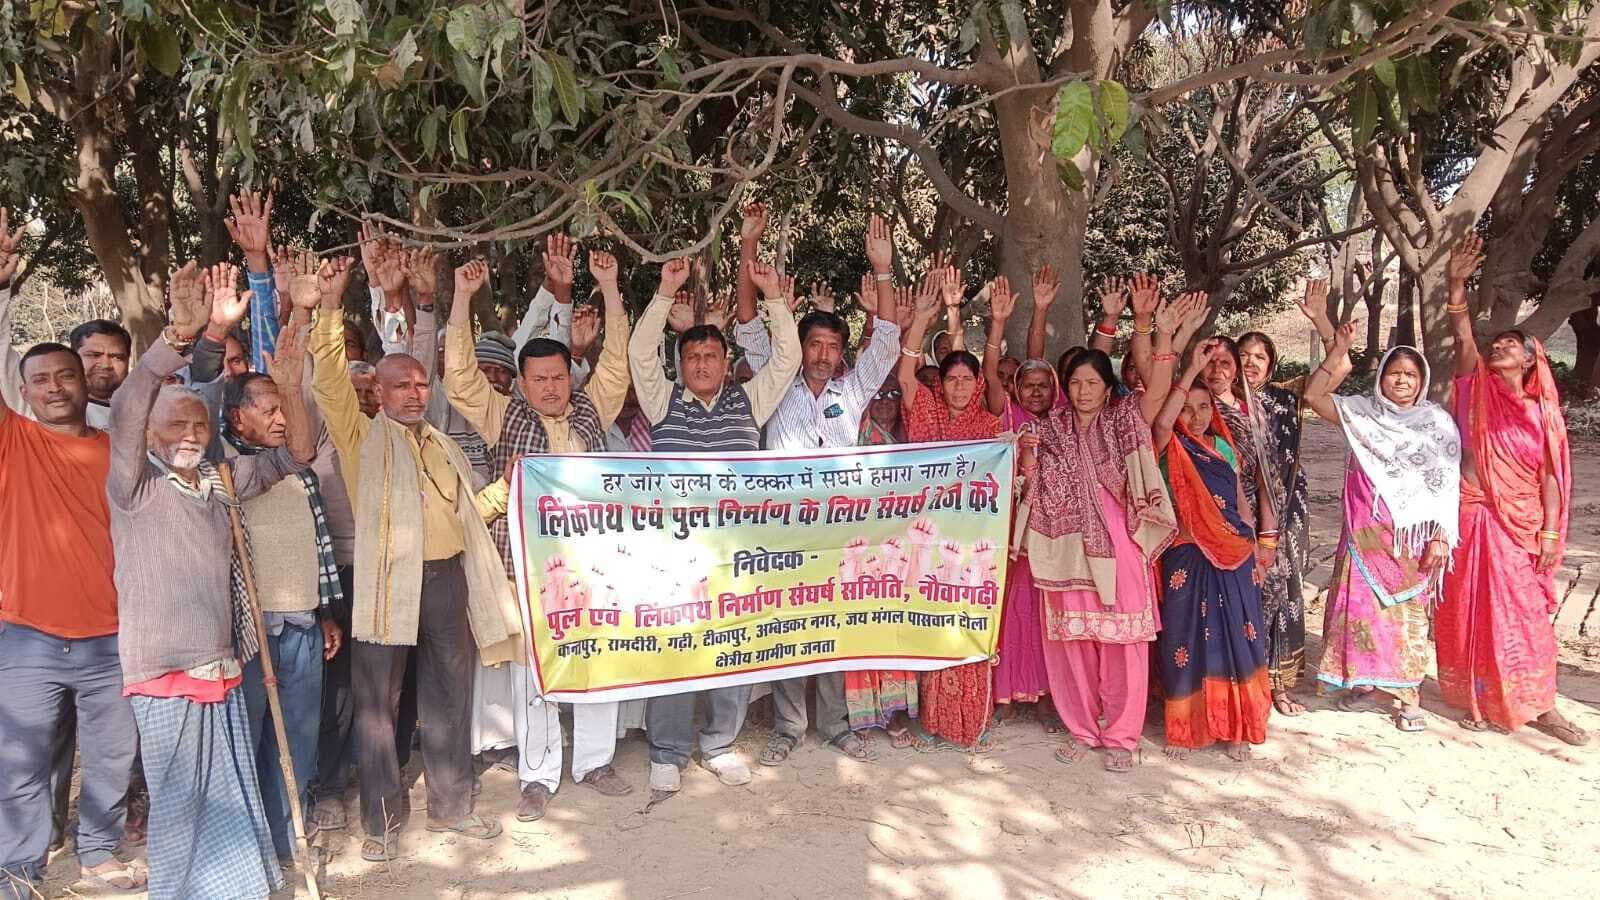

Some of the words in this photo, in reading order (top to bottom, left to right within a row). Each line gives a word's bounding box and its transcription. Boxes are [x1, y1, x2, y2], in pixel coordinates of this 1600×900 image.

[601, 474, 625, 493] हर
[628, 467, 665, 491] जोर
[668, 474, 712, 497] जुल्म
[716, 468, 737, 491] के
[742, 473, 795, 491] टक्कर
[798, 467, 813, 488] में
[819, 462, 863, 488] सघर्ष
[868, 465, 914, 487] हमारा
[919, 462, 952, 479] नारा
[956, 454, 976, 478] है।
[631, 499, 664, 531] एवं
[672, 506, 710, 539] पुल
[717, 498, 791, 526] निर्माण
[799, 498, 821, 525] के
[826, 495, 872, 523] लिए
[877, 486, 930, 519] संघर्ष
[969, 472, 1000, 513] करे
[733, 546, 805, 577] निवेदक
[547, 608, 583, 640] पुल
[588, 603, 622, 626] एवं
[635, 600, 712, 628] लिंकपथ
[718, 585, 783, 618] निर्माण
[788, 576, 835, 606] संघर्ष
[840, 574, 910, 602] समिति,
[608, 635, 662, 653] रामदीरी,
[702, 627, 751, 647] टीकापुर,
[756, 618, 808, 638] अम्बेडकर
[811, 614, 840, 629] नगर,
[846, 611, 868, 625] जय
[871, 607, 904, 623] मंगल
[908, 611, 955, 627] पासवान
[958, 611, 988, 630] टोला
[715, 650, 752, 667] क्षेत्रीय
[755, 643, 797, 662] ग्रामीण
[800, 640, 836, 655] जनता
